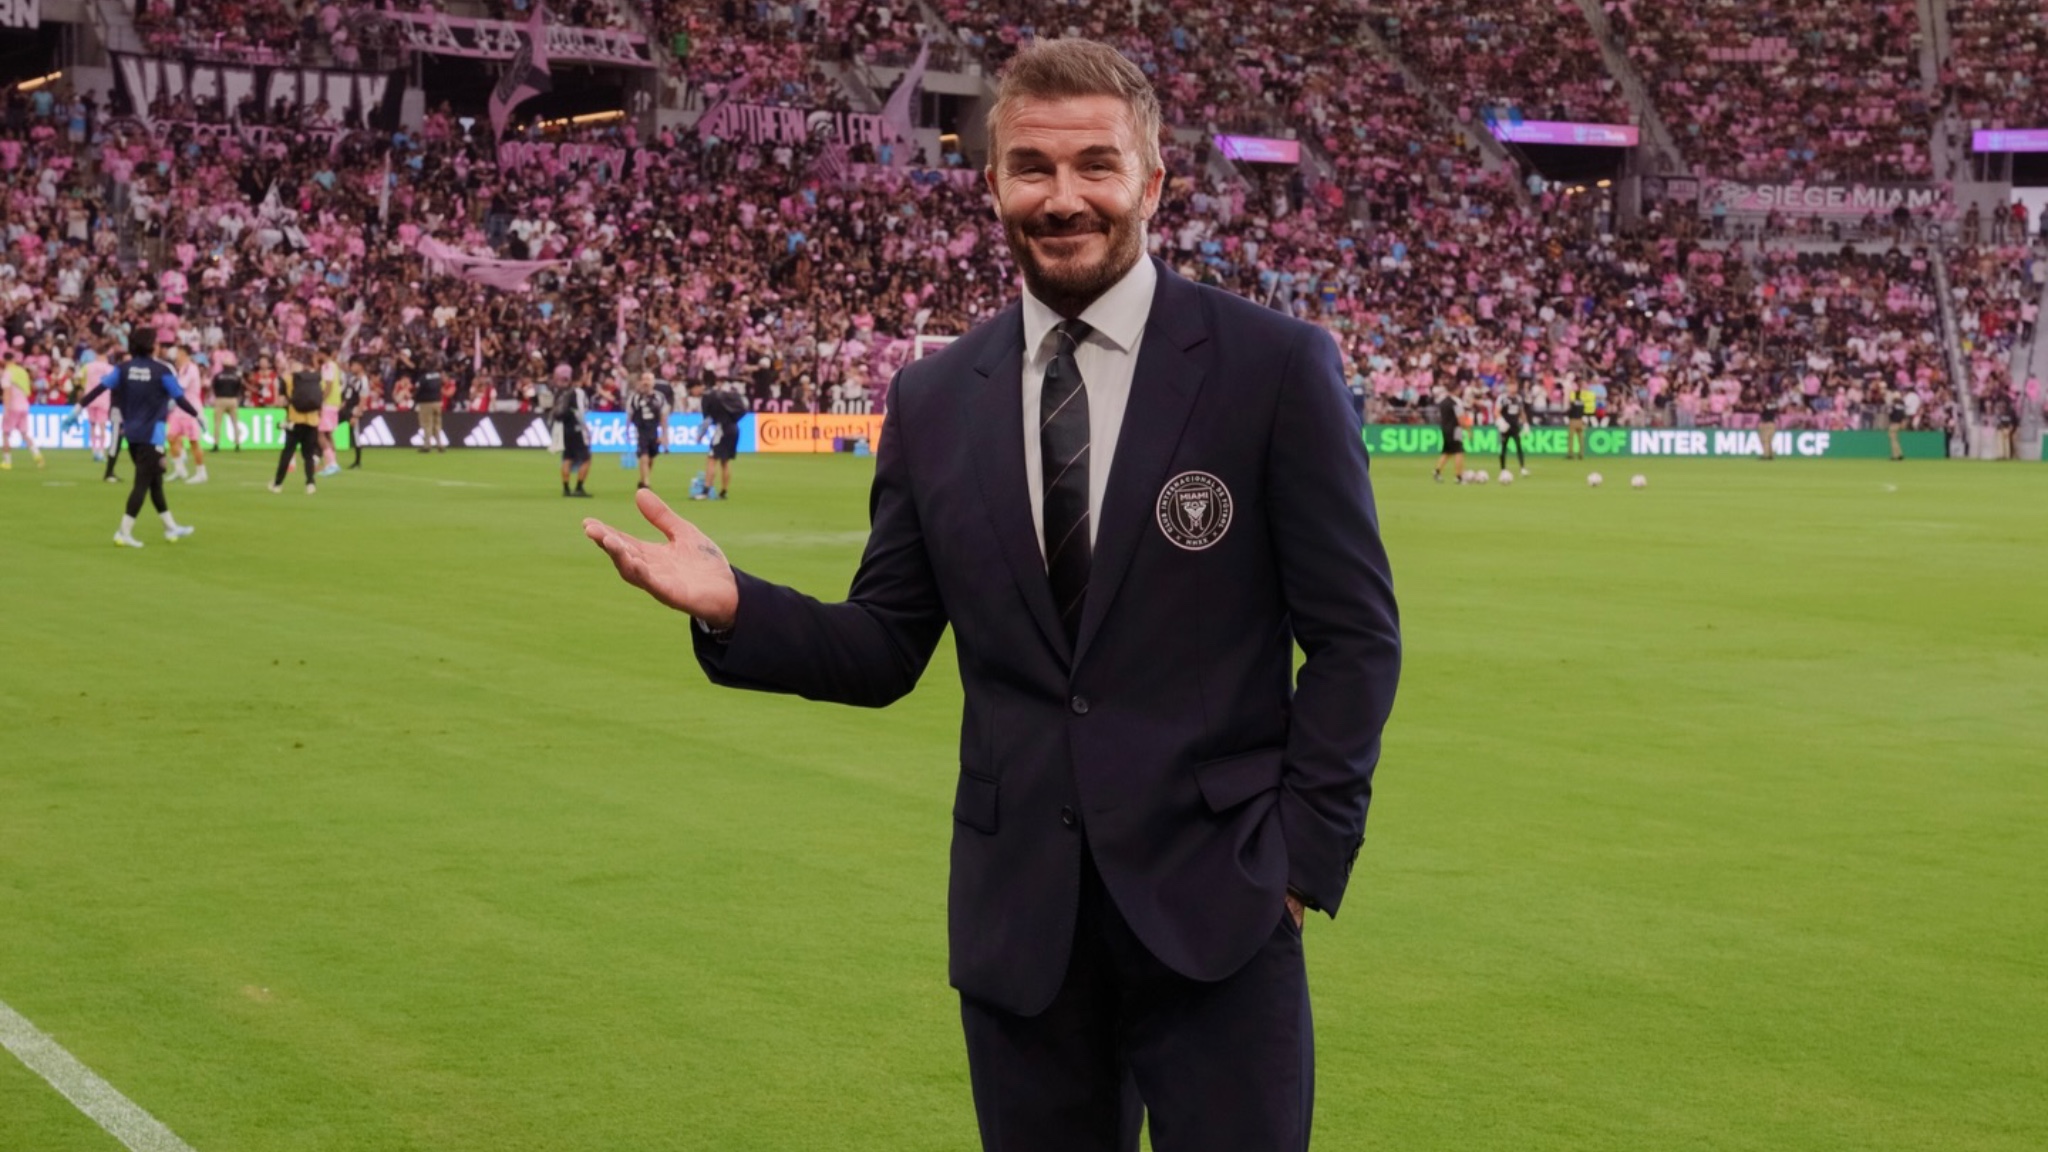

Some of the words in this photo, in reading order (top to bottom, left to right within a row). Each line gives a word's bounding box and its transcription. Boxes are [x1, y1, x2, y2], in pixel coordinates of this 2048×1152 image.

[1756, 185, 1846, 208] SIEGE
[760, 419, 870, 446] Continental
[1380, 428, 1582, 453] SUPMRKE
[1588, 429, 1627, 454] OF
[1631, 430, 1708, 454] INTER
[1796, 431, 1831, 455] CF
[1179, 491, 1209, 501] MIAMI
